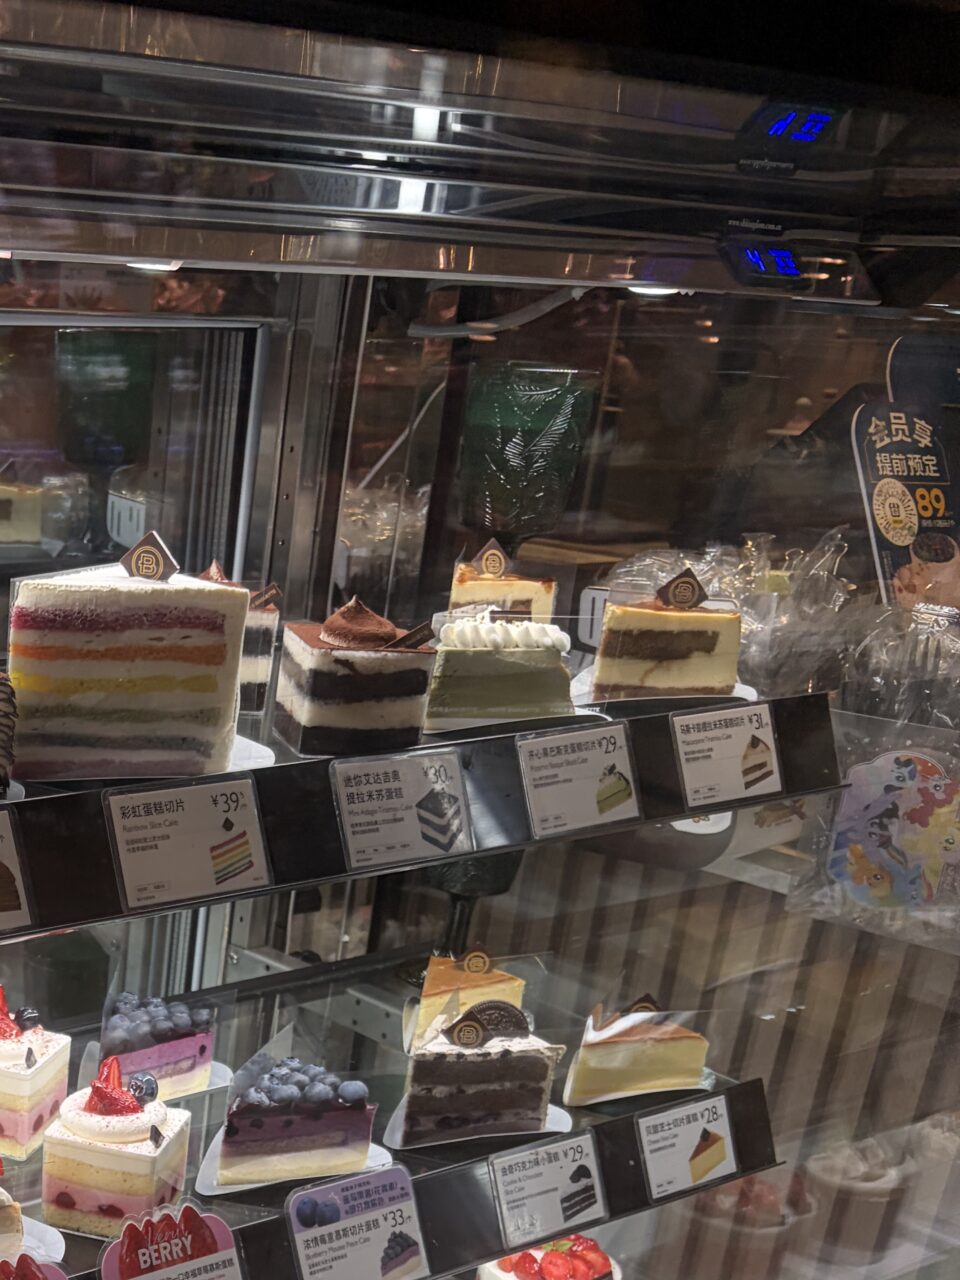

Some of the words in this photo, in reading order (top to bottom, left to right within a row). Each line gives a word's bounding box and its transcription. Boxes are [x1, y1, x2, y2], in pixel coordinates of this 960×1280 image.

[867, 412, 933, 449] 会员享
[877, 453, 940, 477] 提前预定
[915, 488, 945, 518] 89
[747, 711, 769, 730] ¥31
[596, 733, 622, 755] ¥29
[422, 763, 453, 785] ¥30
[210, 790, 247, 814] ¥39
[345, 786, 404, 805] 提拉米苏蛋糕
[119, 798, 185, 820] 彩虹蛋糕切片
[562, 1142, 589, 1165] ¥29
[302, 1218, 380, 1251] 浓情莓意慕斯切片蛋糕
[138, 1234, 192, 1269] BERRY
